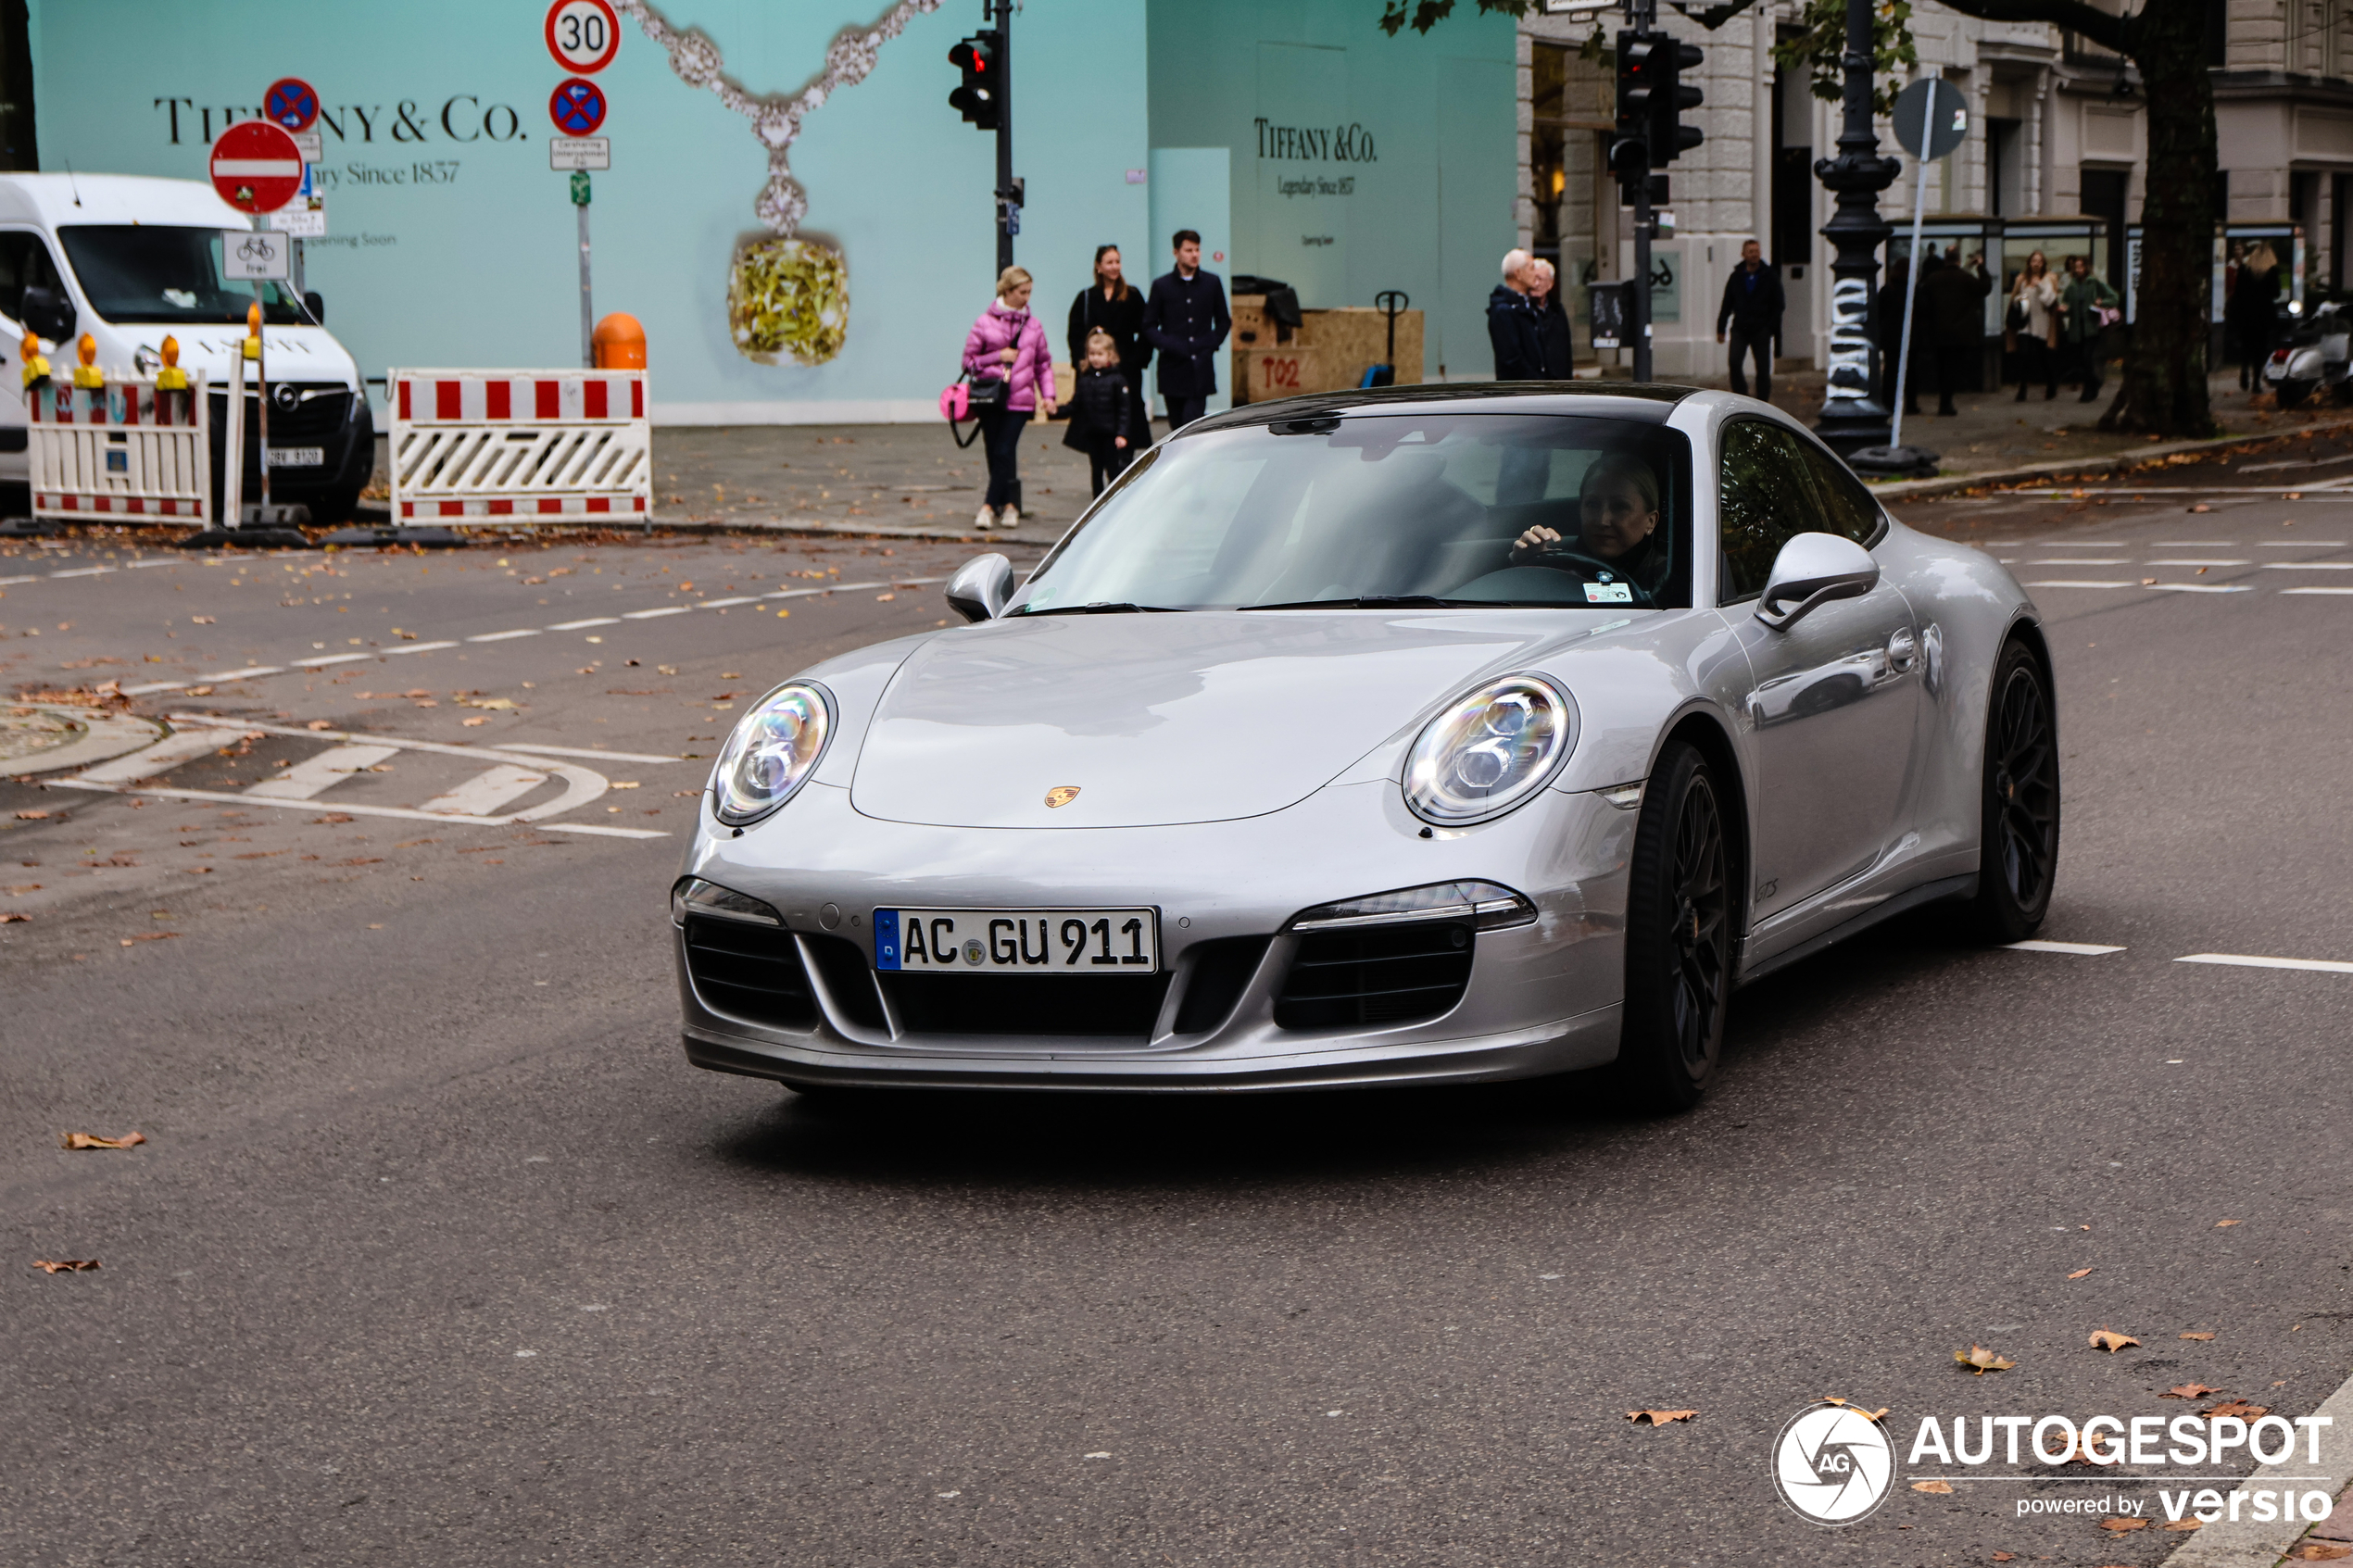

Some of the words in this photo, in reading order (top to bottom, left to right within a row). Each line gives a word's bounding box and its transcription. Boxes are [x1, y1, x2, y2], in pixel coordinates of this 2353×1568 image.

[561, 15, 603, 51] 30
[154, 96, 383, 145] TINY
[391, 99, 431, 144] &
[1254, 117, 1330, 161] TIFFANY
[347, 161, 406, 184] Since
[361, 232, 397, 246] Soon
[245, 262, 267, 274] frei
[1755, 878, 1779, 903] GTS
[903, 917, 958, 964] AC
[989, 918, 1050, 965] GU
[1060, 918, 1149, 965] 911
